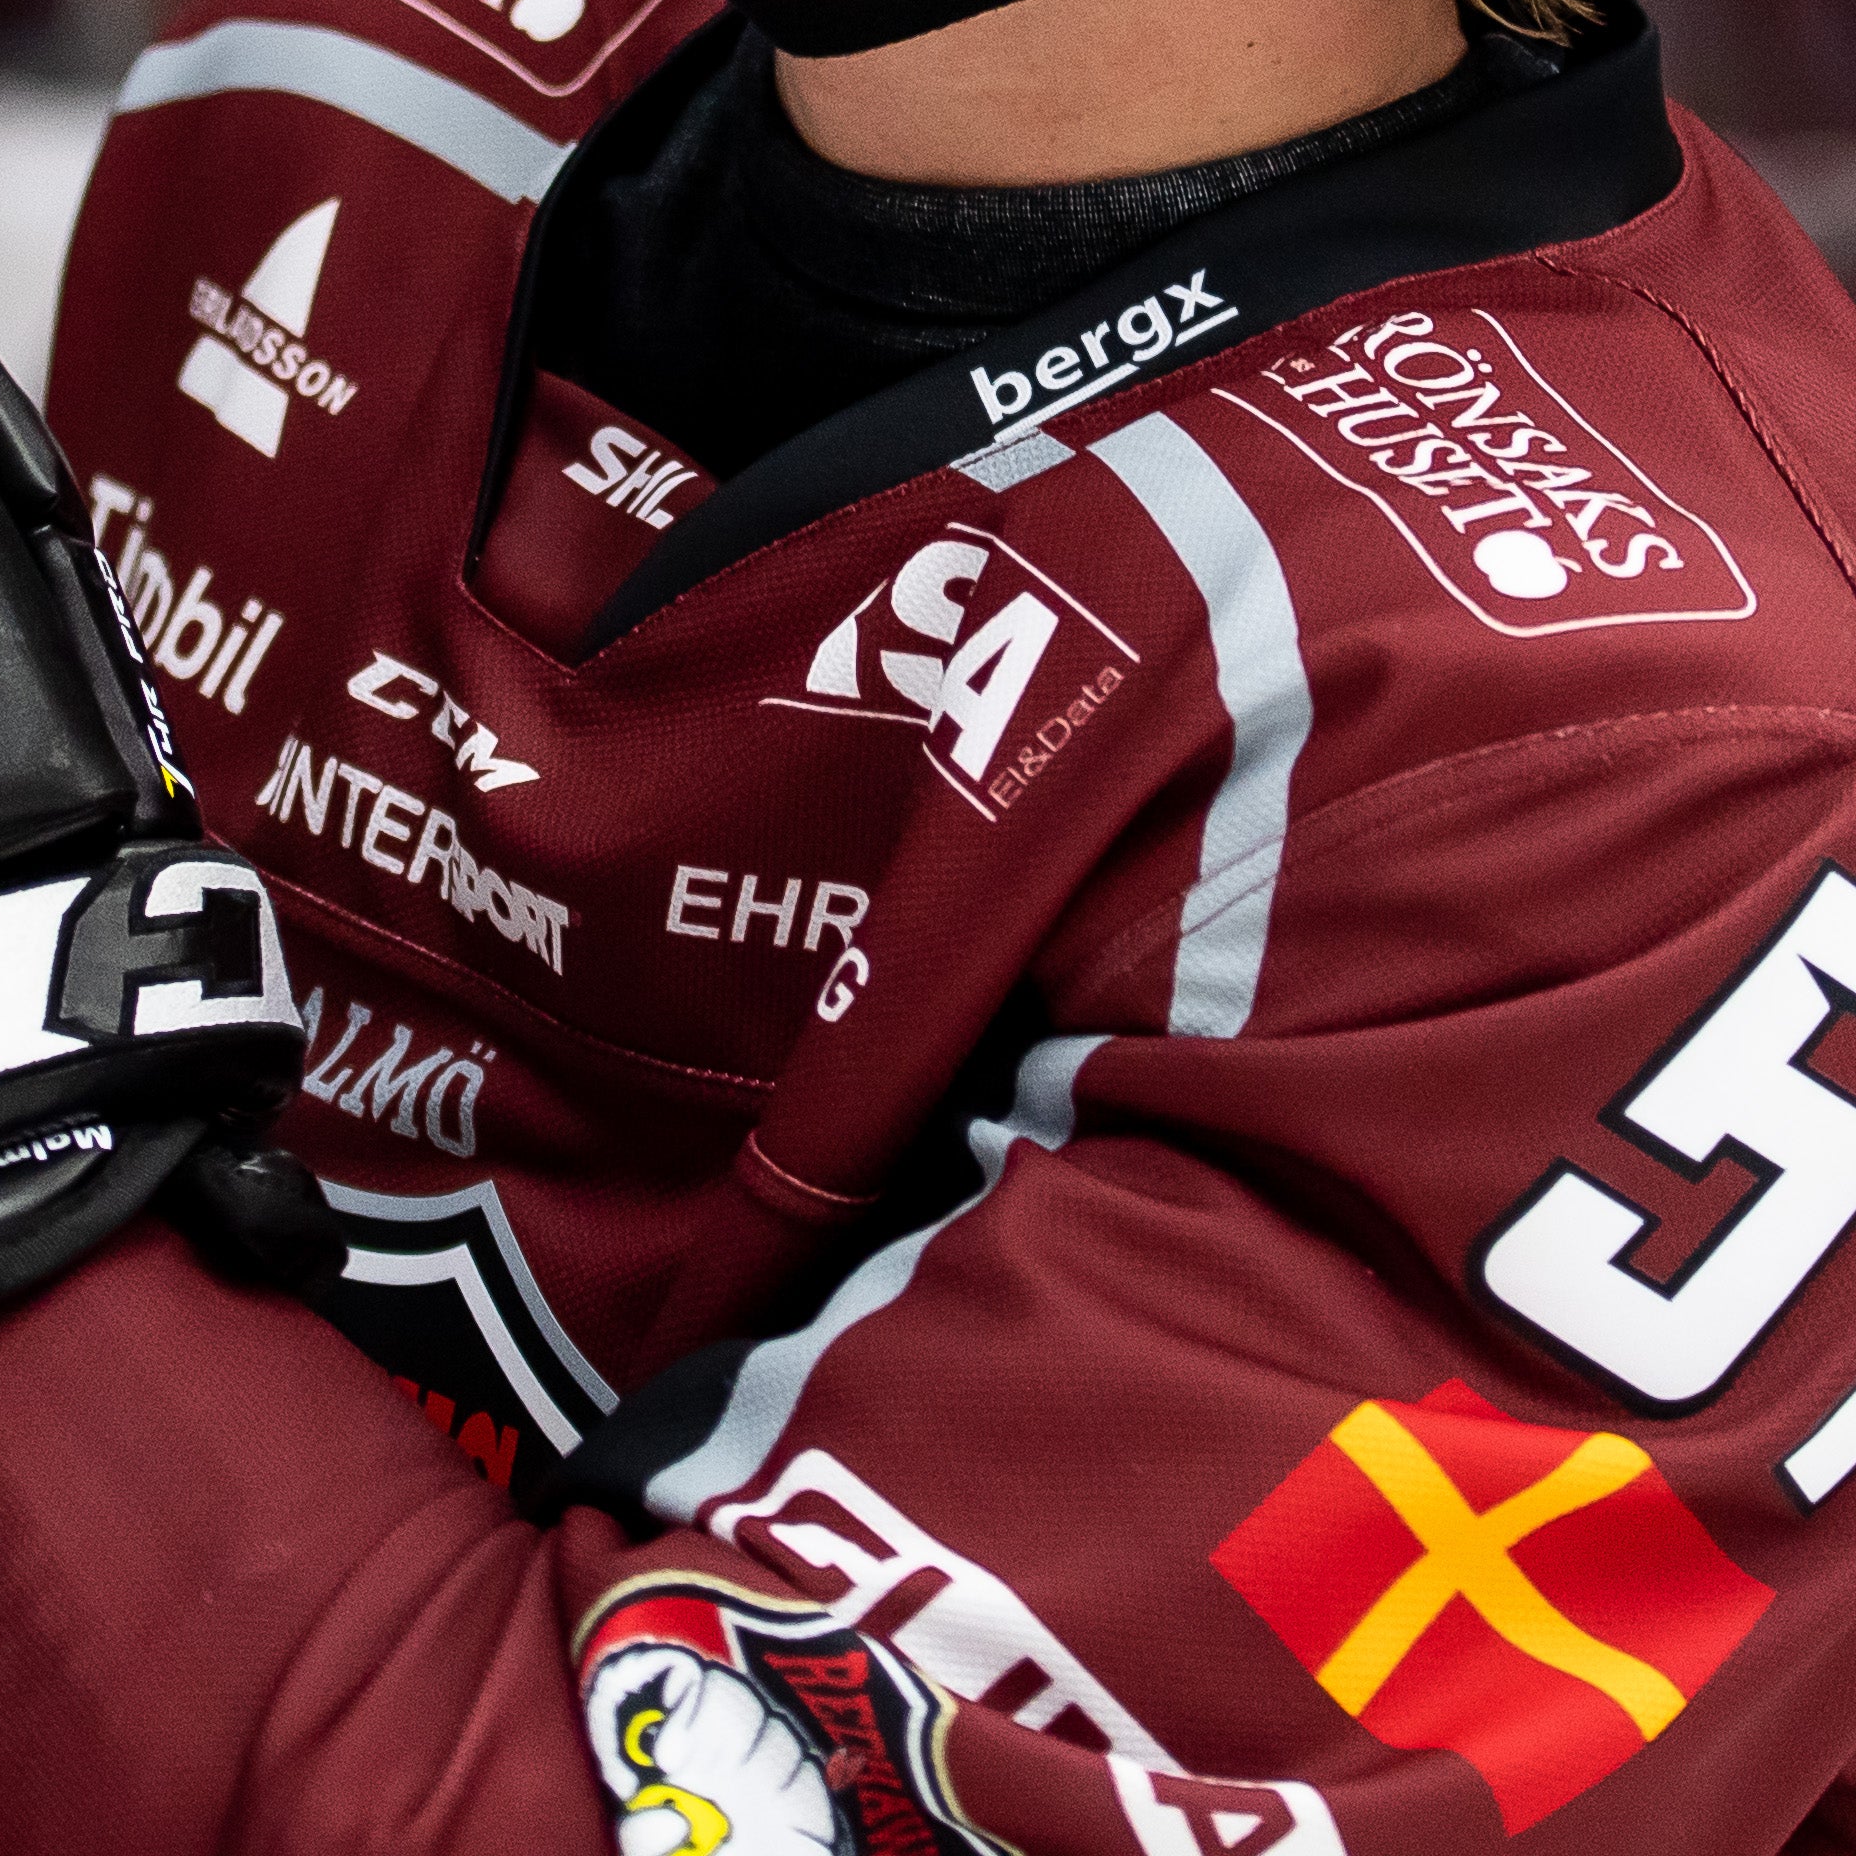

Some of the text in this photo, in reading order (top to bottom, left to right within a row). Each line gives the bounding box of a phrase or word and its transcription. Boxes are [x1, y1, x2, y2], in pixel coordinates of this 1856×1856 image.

[971, 269, 1223, 426] bergx
[562, 425, 698, 530] SHL
[1282, 361, 1554, 536] HUSET
[1328, 310, 1684, 580] RÖNSAKS
[347, 648, 541, 793] CCM
